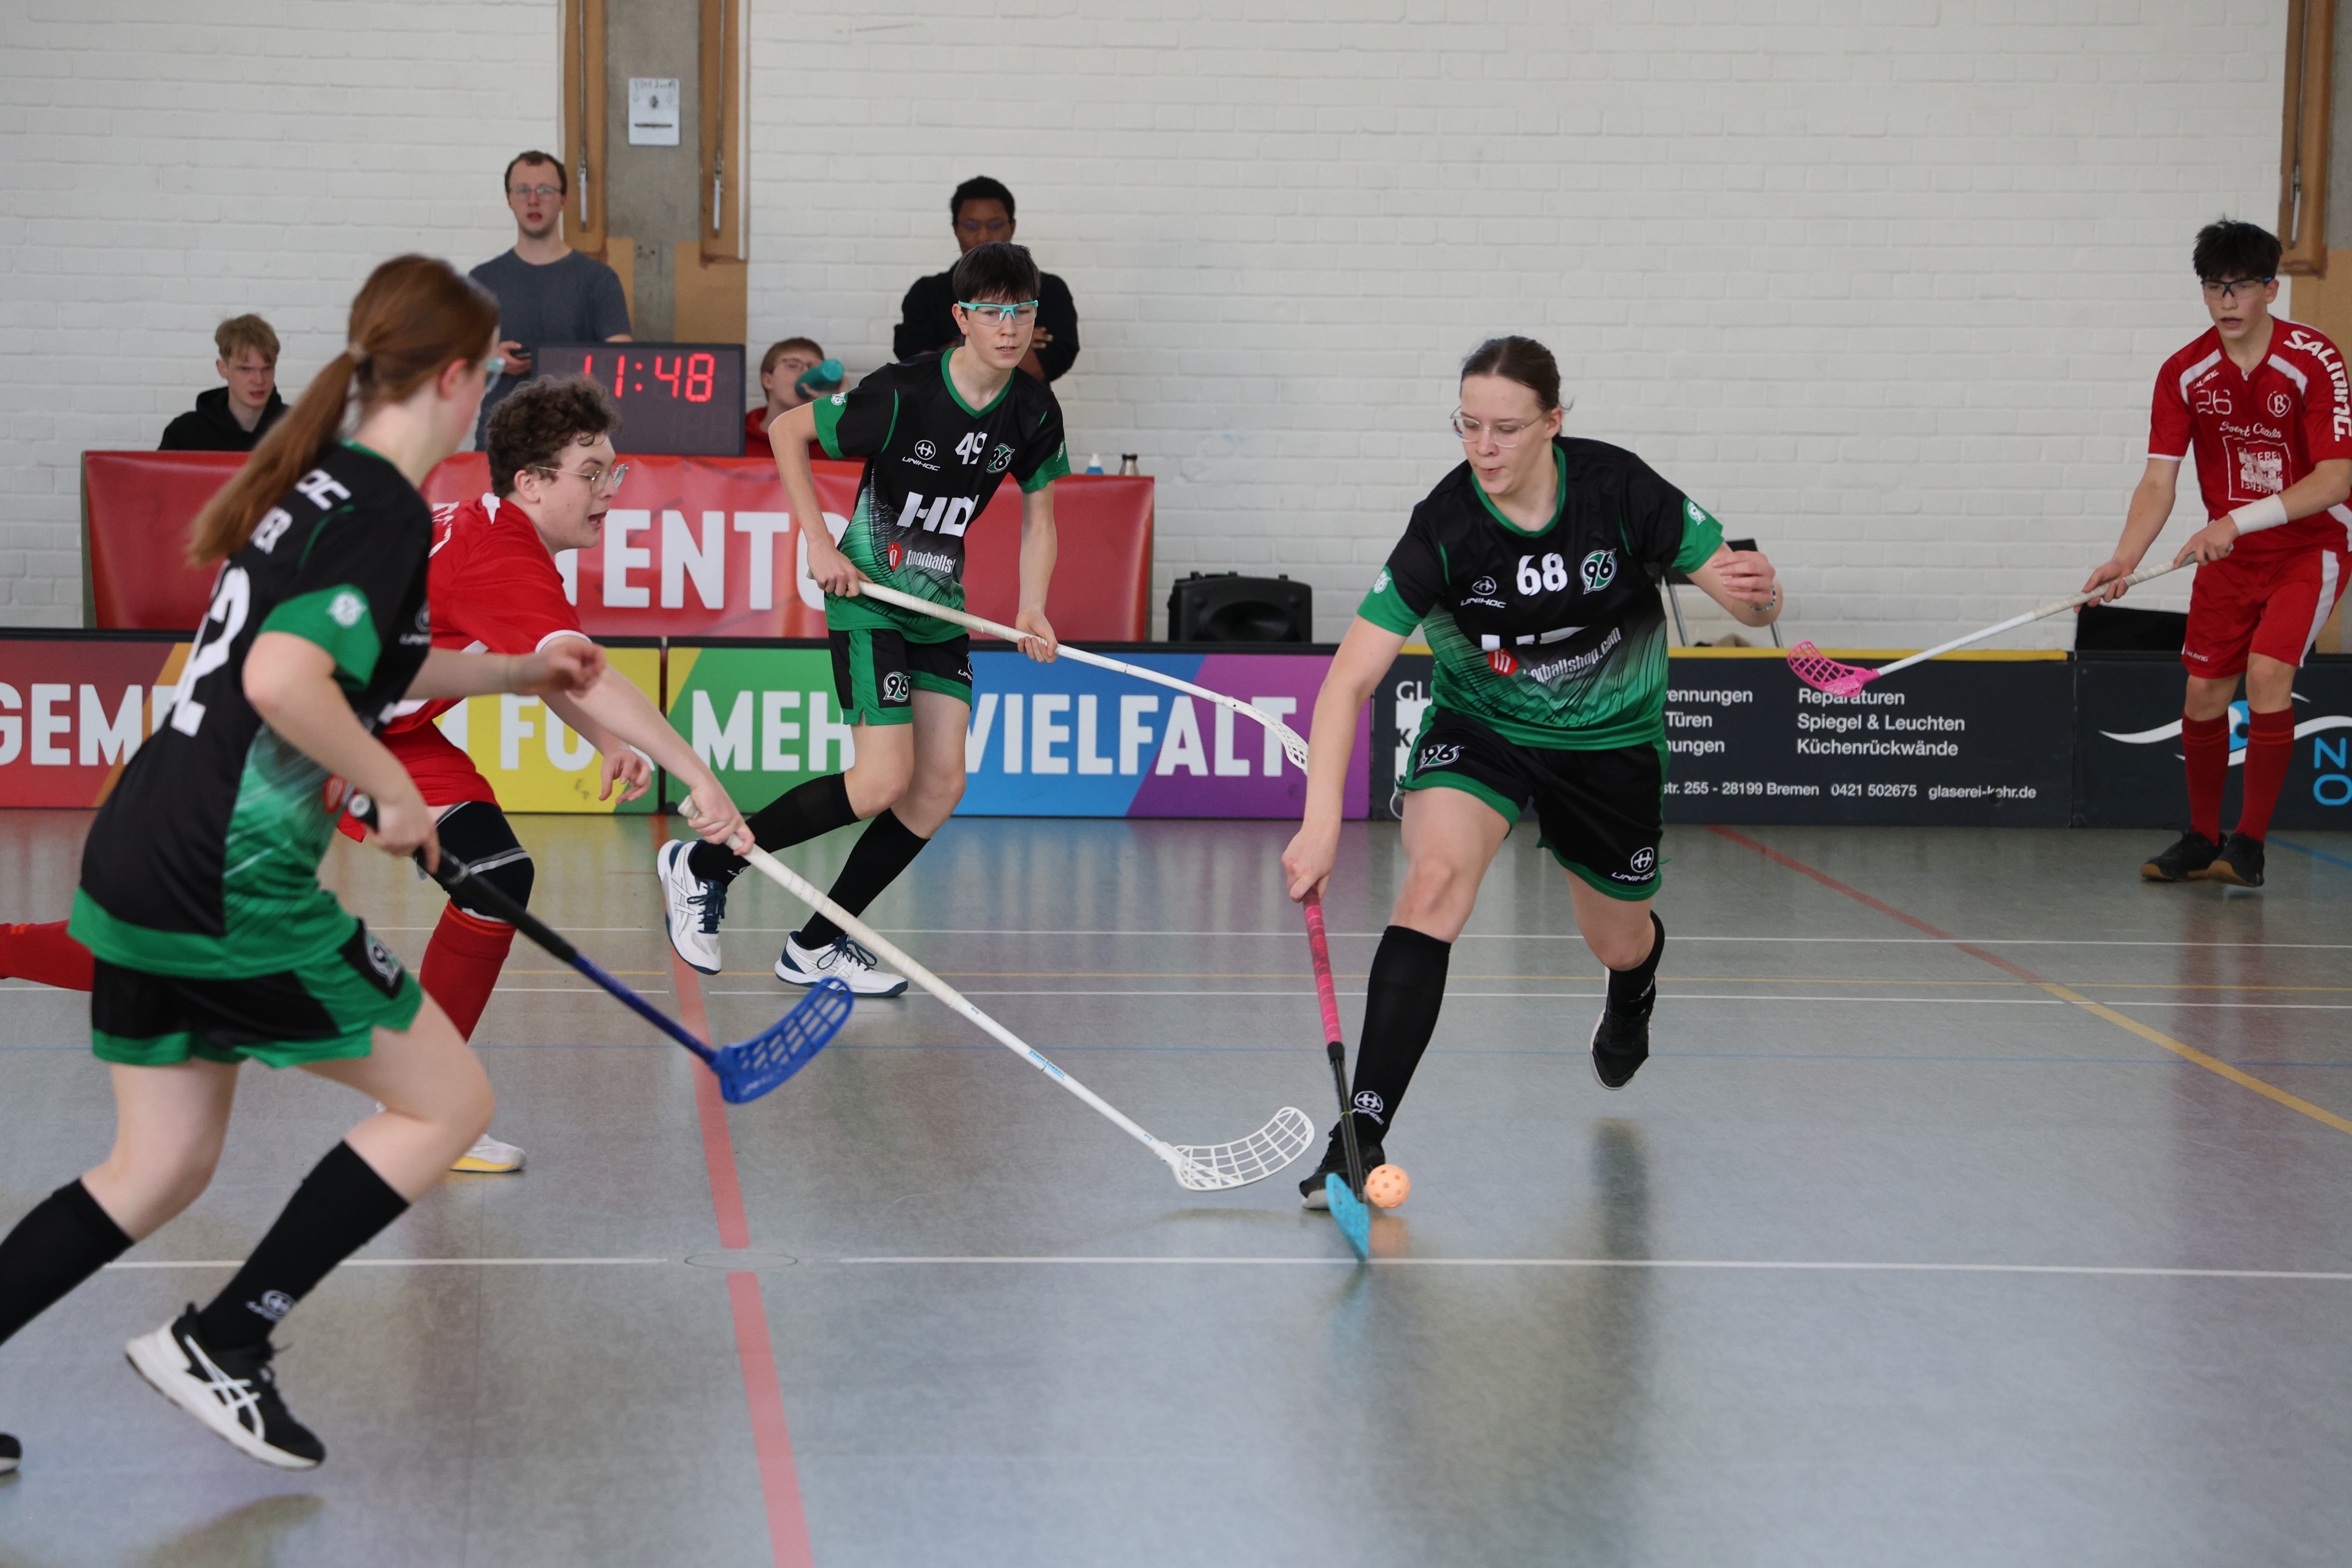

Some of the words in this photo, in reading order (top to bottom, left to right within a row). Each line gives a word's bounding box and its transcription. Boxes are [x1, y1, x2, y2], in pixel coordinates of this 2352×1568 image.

[2195, 389, 2232, 415] 26
[955, 432, 988, 464] 49
[902, 457, 940, 471] UNIHOC
[897, 491, 980, 537] HD
[1516, 552, 1568, 596] 68
[1582, 551, 1615, 592] 96
[1461, 597, 1506, 609] UNIHOC
[885, 673, 910, 699] 96
[692, 690, 855, 772] MEH
[1665, 711, 1713, 727] Türen
[1798, 713, 1862, 733] Spiegel
[1867, 714, 1879, 730] &
[1885, 715, 1965, 731] Leuchten
[1797, 738, 1958, 756] Küchenrückwände
[1684, 782, 1709, 795] 255
[1722, 782, 1763, 796] 28199
[1767, 782, 1819, 796] Bremen
[1831, 784, 1862, 797] 0421
[1868, 784, 1917, 798] 502675
